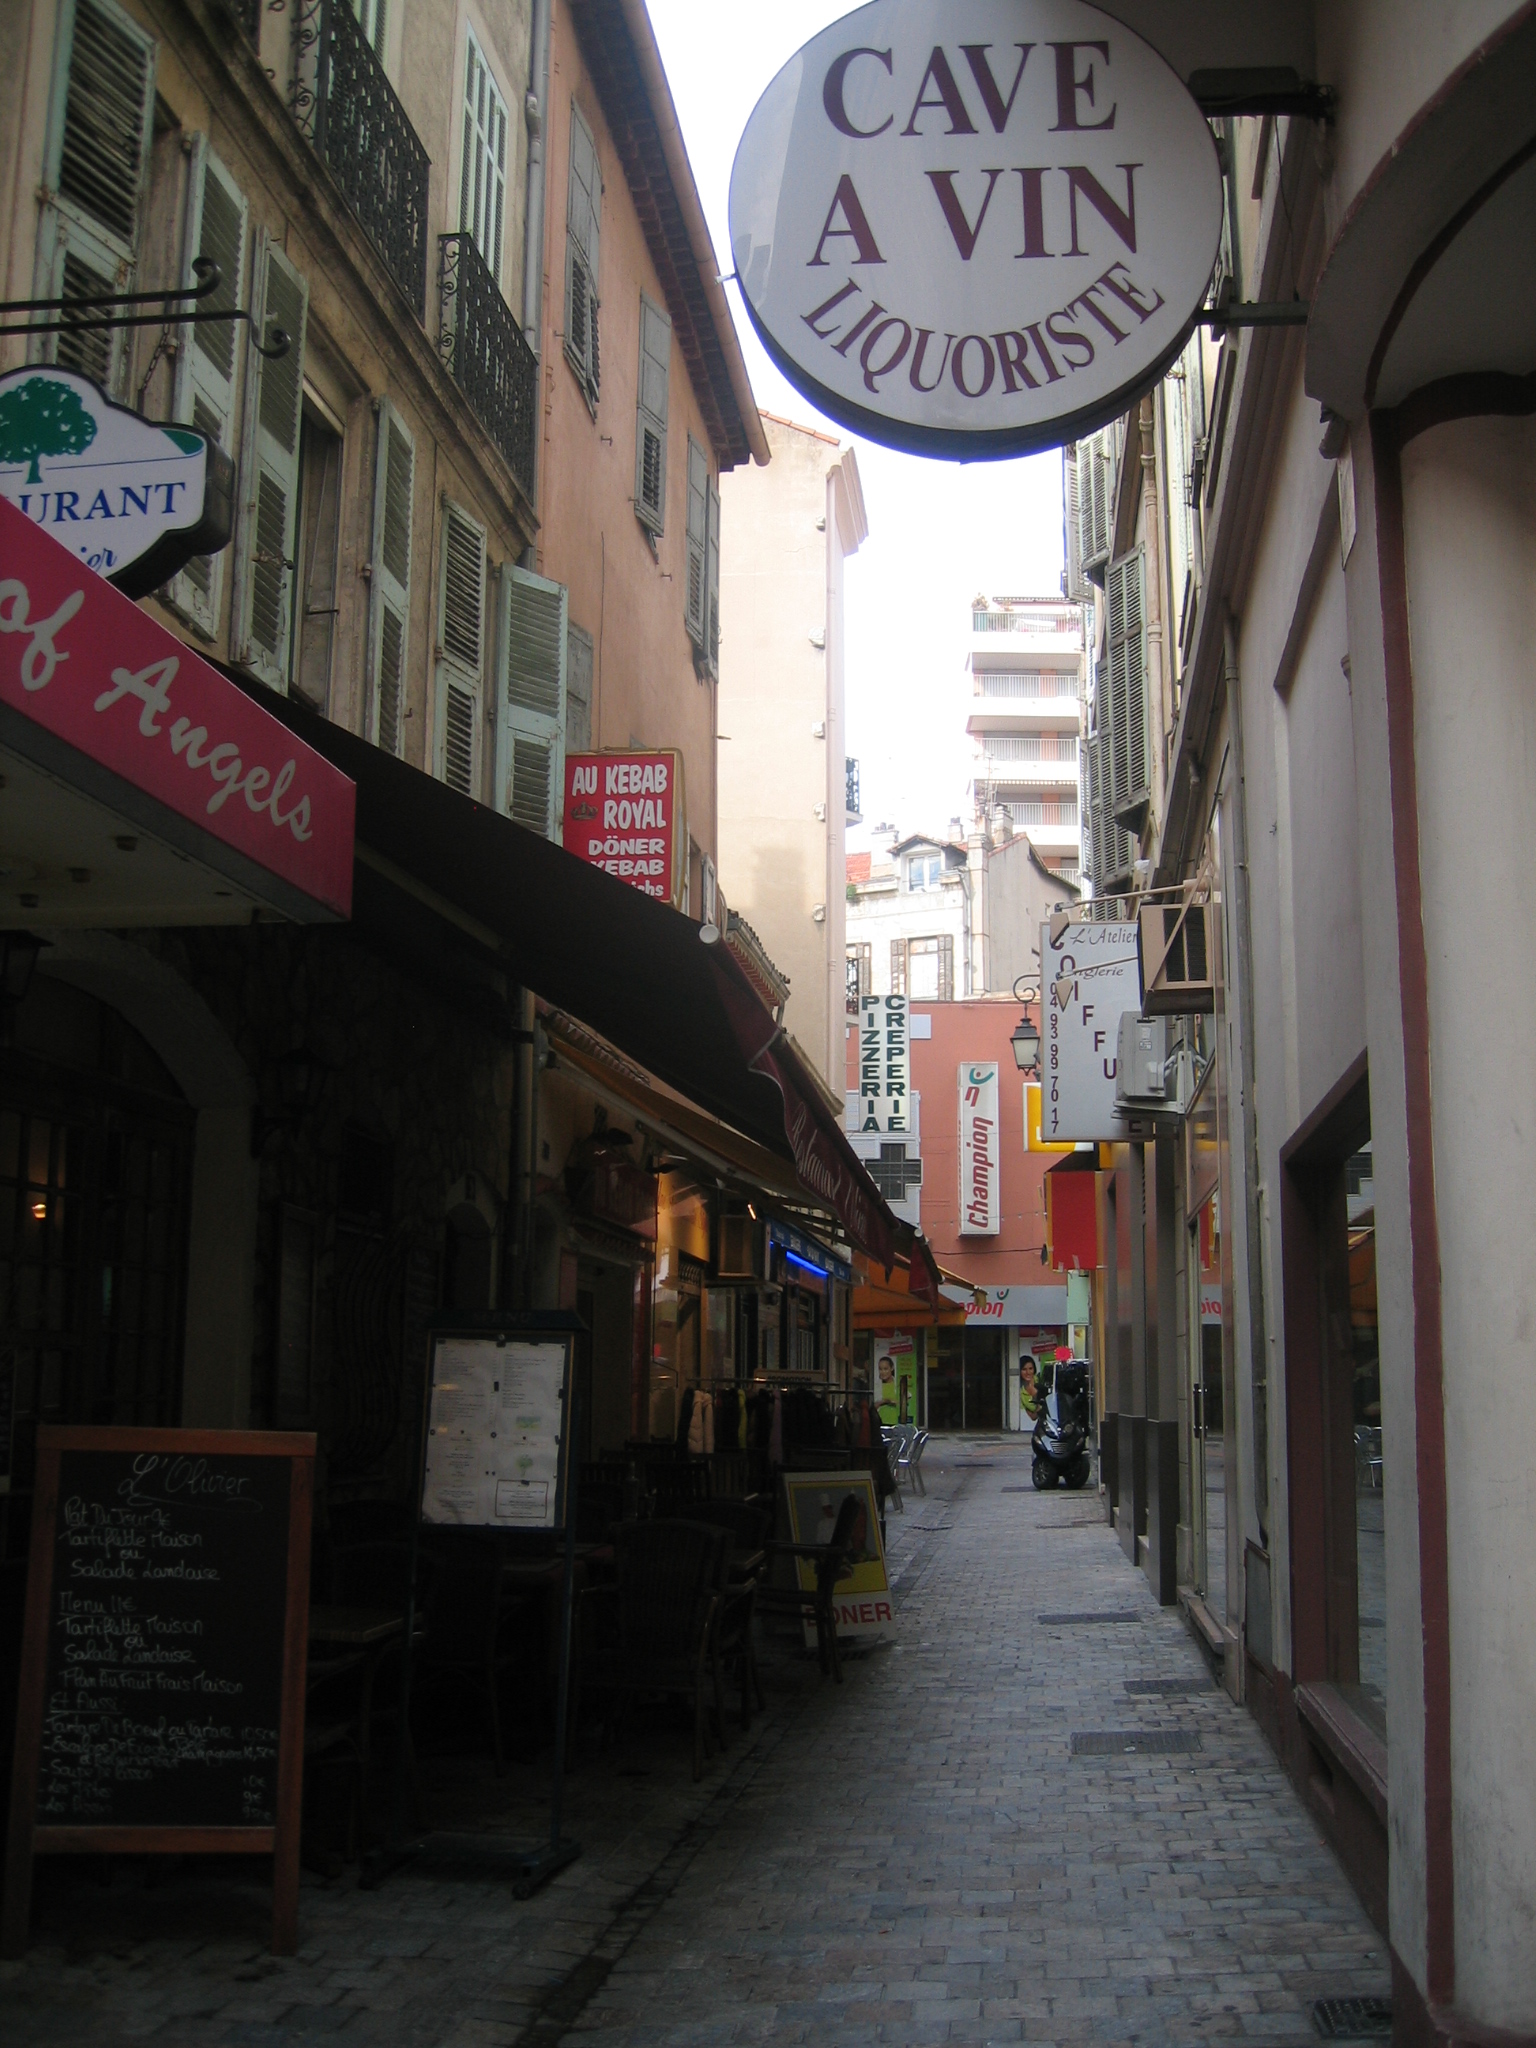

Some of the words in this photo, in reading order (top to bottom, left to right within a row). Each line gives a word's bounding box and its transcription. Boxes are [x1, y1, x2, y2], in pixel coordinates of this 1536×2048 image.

[822, 40, 1117, 139] CAVE
[806, 173, 888, 267] A
[924, 163, 1144, 261] VIN
[800, 260, 1166, 399] LIQUORISTE
[6, 482, 187, 524] URANT
[0, 578, 85, 692] of
[93, 655, 313, 842] Angels
[571, 765, 598, 797] AU
[605, 763, 668, 796] KEBAB
[603, 798, 667, 830] ROYAL
[588, 835, 666, 856] DÖNER
[861, 996, 881, 1132] PIZZERIA
[885, 995, 906, 1131] CREPERIE
[967, 1116, 994, 1229] Champion
[958, 1301, 1005, 1319] pion
[59, 1591, 106, 1613] Menu
